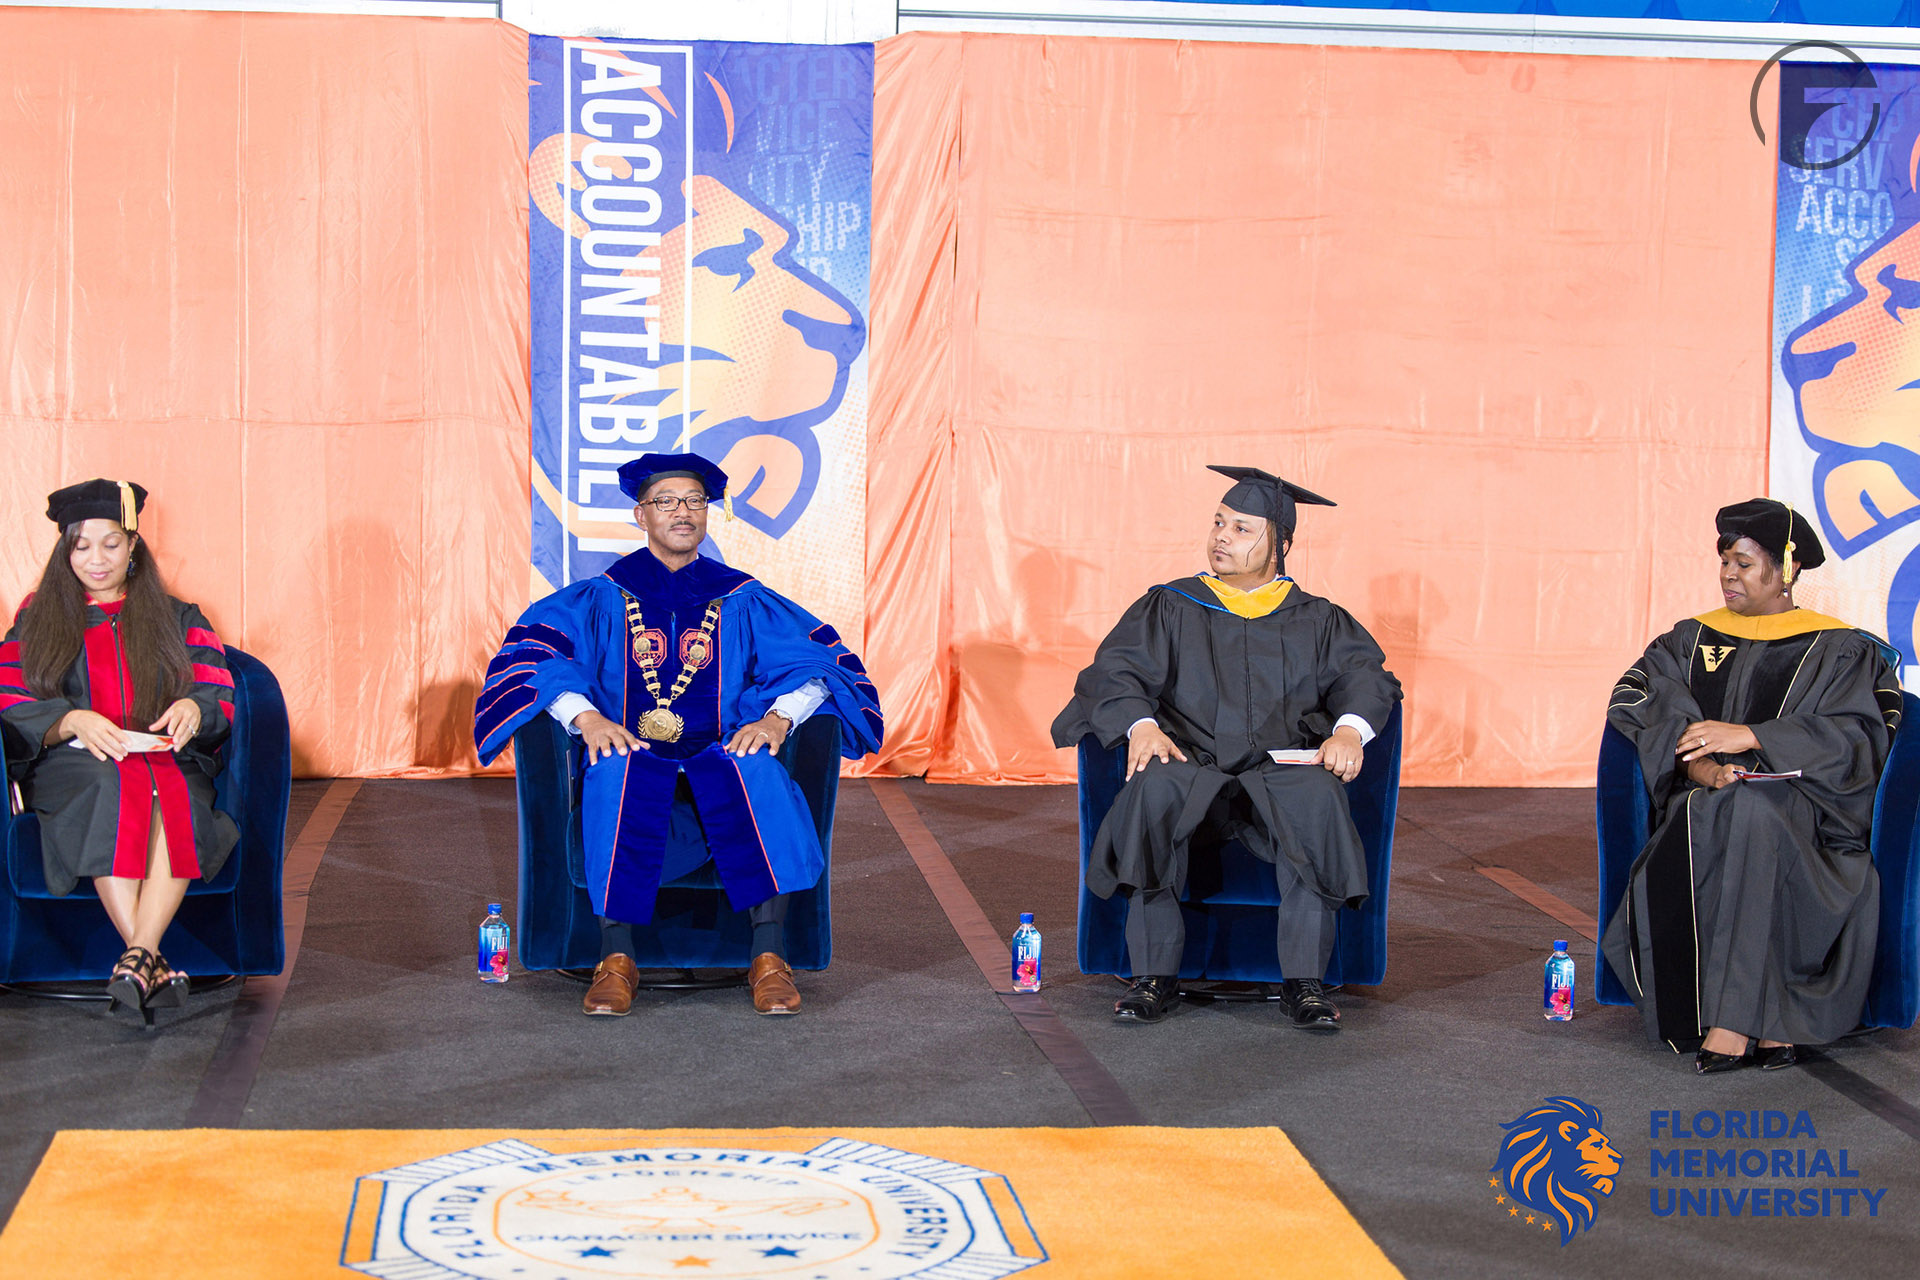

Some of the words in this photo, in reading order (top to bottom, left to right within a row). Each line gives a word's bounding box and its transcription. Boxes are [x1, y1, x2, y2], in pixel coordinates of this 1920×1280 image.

[1789, 137, 1893, 191] SERV
[777, 201, 861, 253] HIP
[491, 936, 508, 951] FIJI
[429, 1184, 501, 1260] FLORIDA
[517, 1152, 844, 1174] MEMORIAL
[860, 1175, 949, 1260] UNIVERSITY
[514, 1233, 713, 1243] CHARACTER
[722, 1231, 863, 1242] SERVICE
